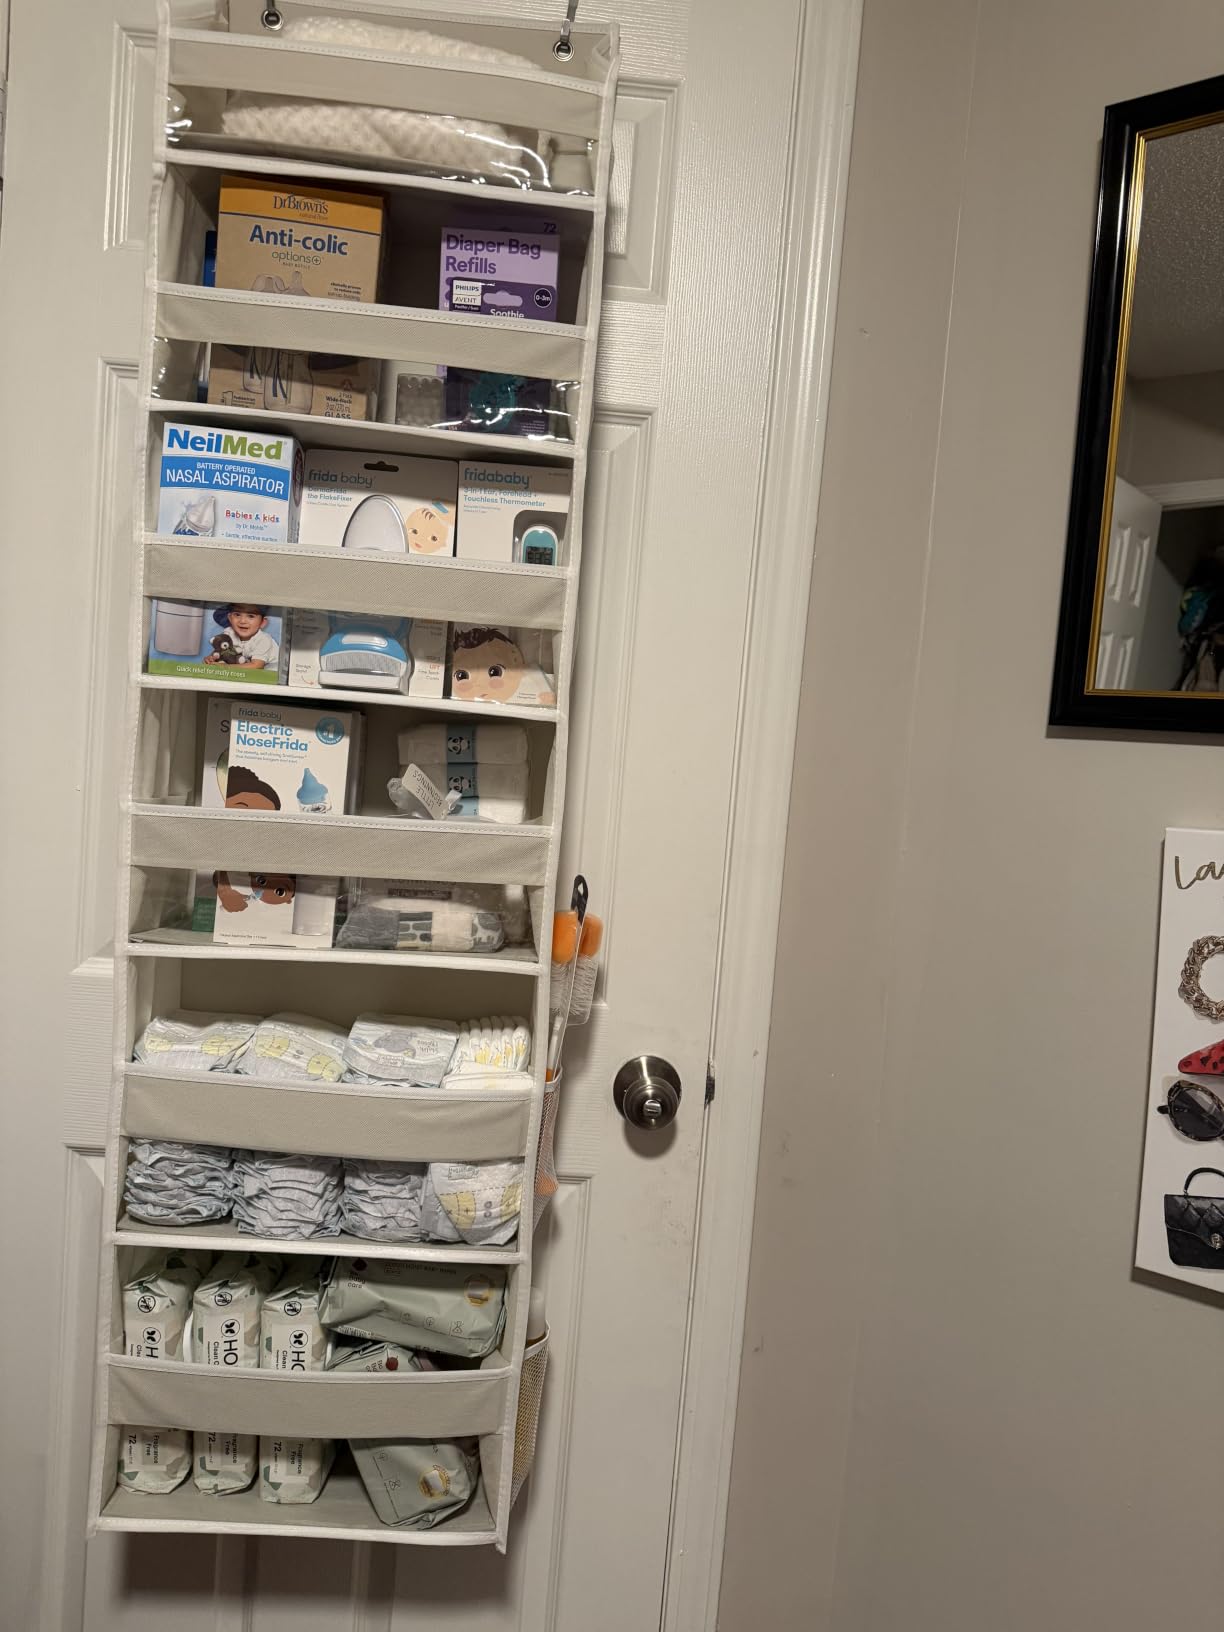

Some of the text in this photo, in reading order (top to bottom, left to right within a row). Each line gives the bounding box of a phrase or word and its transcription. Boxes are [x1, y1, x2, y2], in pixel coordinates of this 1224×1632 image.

[543, 222, 557, 233] 72
[249, 224, 349, 256] Anti-colic
[446, 234, 541, 260] Diaper Bag
[445, 255, 497, 274] Refills
[455, 284, 479, 292] PHILIPS
[167, 428, 283, 460] NeilMed
[196, 462, 256, 475] BATTERY OPERATED
[166, 468, 285, 495] NASAL ASPIRATOR
[308, 469, 373, 488] frida baby
[464, 468, 530, 489] fridababy
[319, 493, 353, 502] FlakeFixer
[464, 495, 546, 507] Touchless Thermometer
[499, 489, 532, 498] Forehead
[225, 509, 253, 520] Babies
[262, 513, 280, 523] kids
[176, 665, 192, 673] Quick
[238, 708, 281, 721] frida baby
[237, 720, 293, 737] Electric
[236, 733, 308, 751] NoseFrida
[412, 770, 442, 807] BEGINNINGS
[415, 788, 435, 810] LITTLE
[223, 1339, 238, 1365] HO
[128, 1434, 137, 1445] 72
[207, 1432, 216, 1442] 72
[274, 1441, 282, 1452] 72
